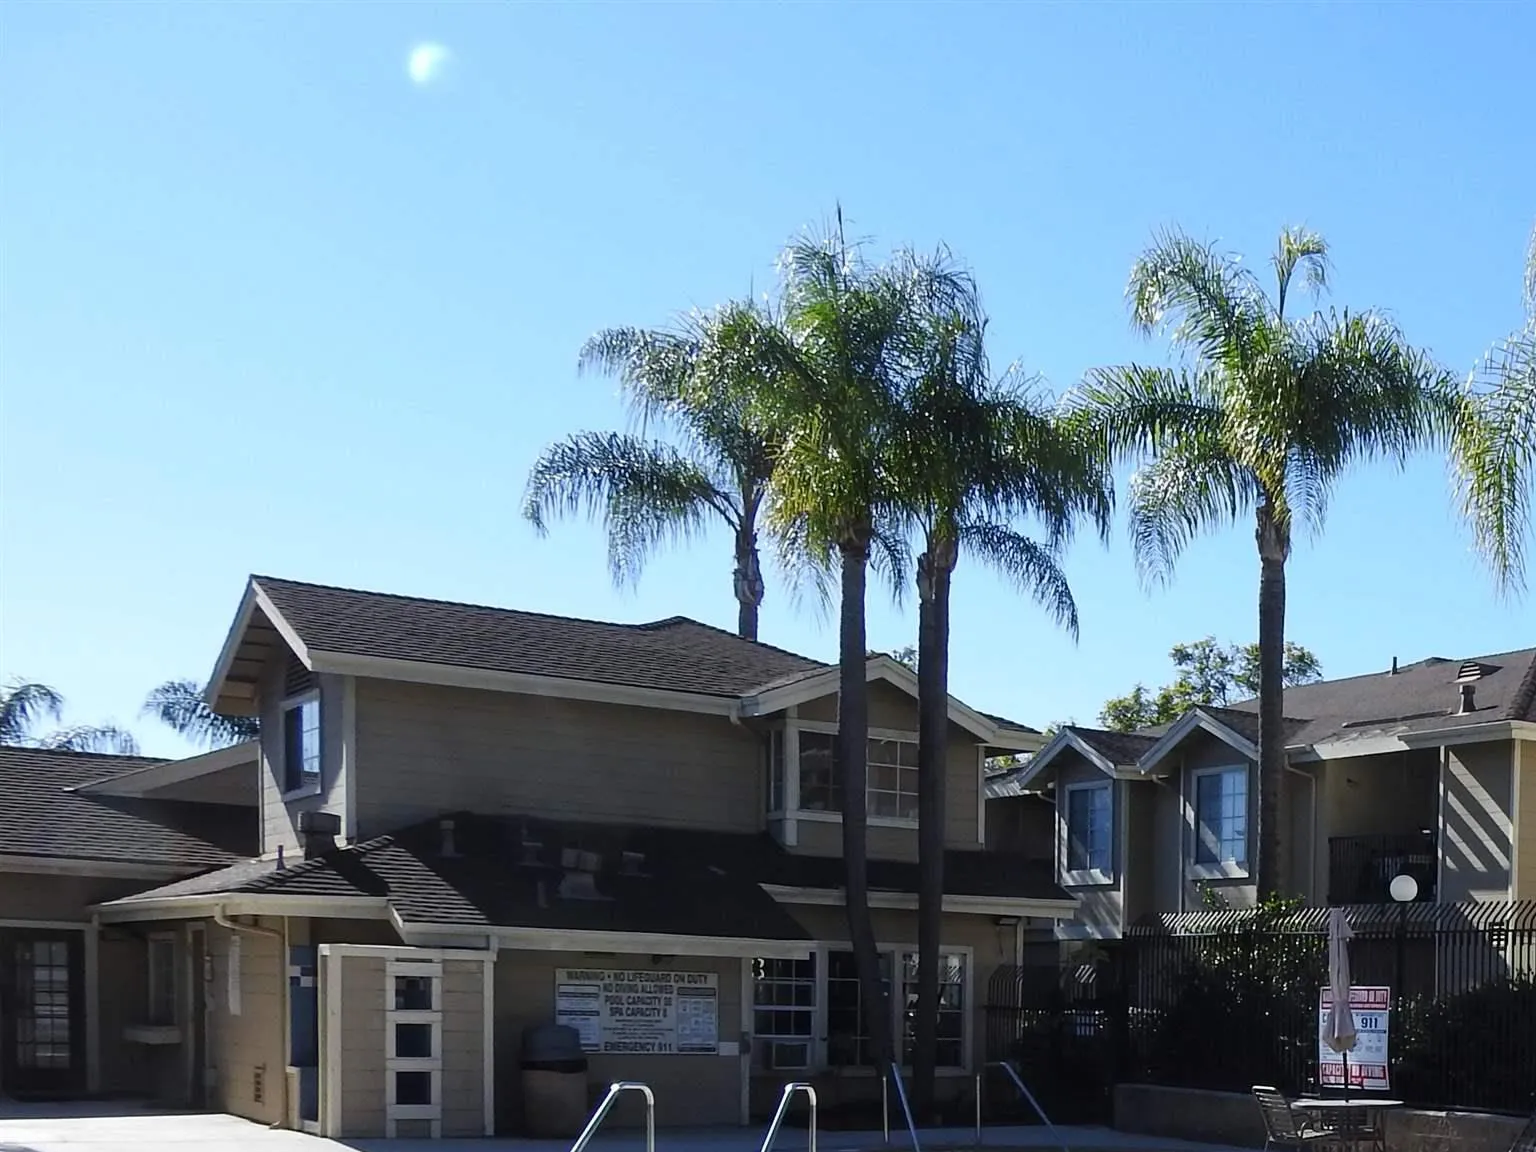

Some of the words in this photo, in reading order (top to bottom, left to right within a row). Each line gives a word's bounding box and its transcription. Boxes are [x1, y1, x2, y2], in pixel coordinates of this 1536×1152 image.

[613, 972, 626, 982] NO
[627, 972, 672, 983] LIFEGUARD
[673, 974, 685, 983] ON
[687, 974, 708, 984] DUTY
[641, 984, 674, 994] ALLOWED
[604, 995, 625, 1006] POOL
[627, 995, 661, 1006] CAPACITY
[609, 1007, 624, 1017] SPA
[626, 1007, 661, 1017] CAPACITY
[1361, 1017, 1378, 1028] 911
[604, 1041, 655, 1052] EMERGENCY
[658, 1042, 672, 1052] 911
